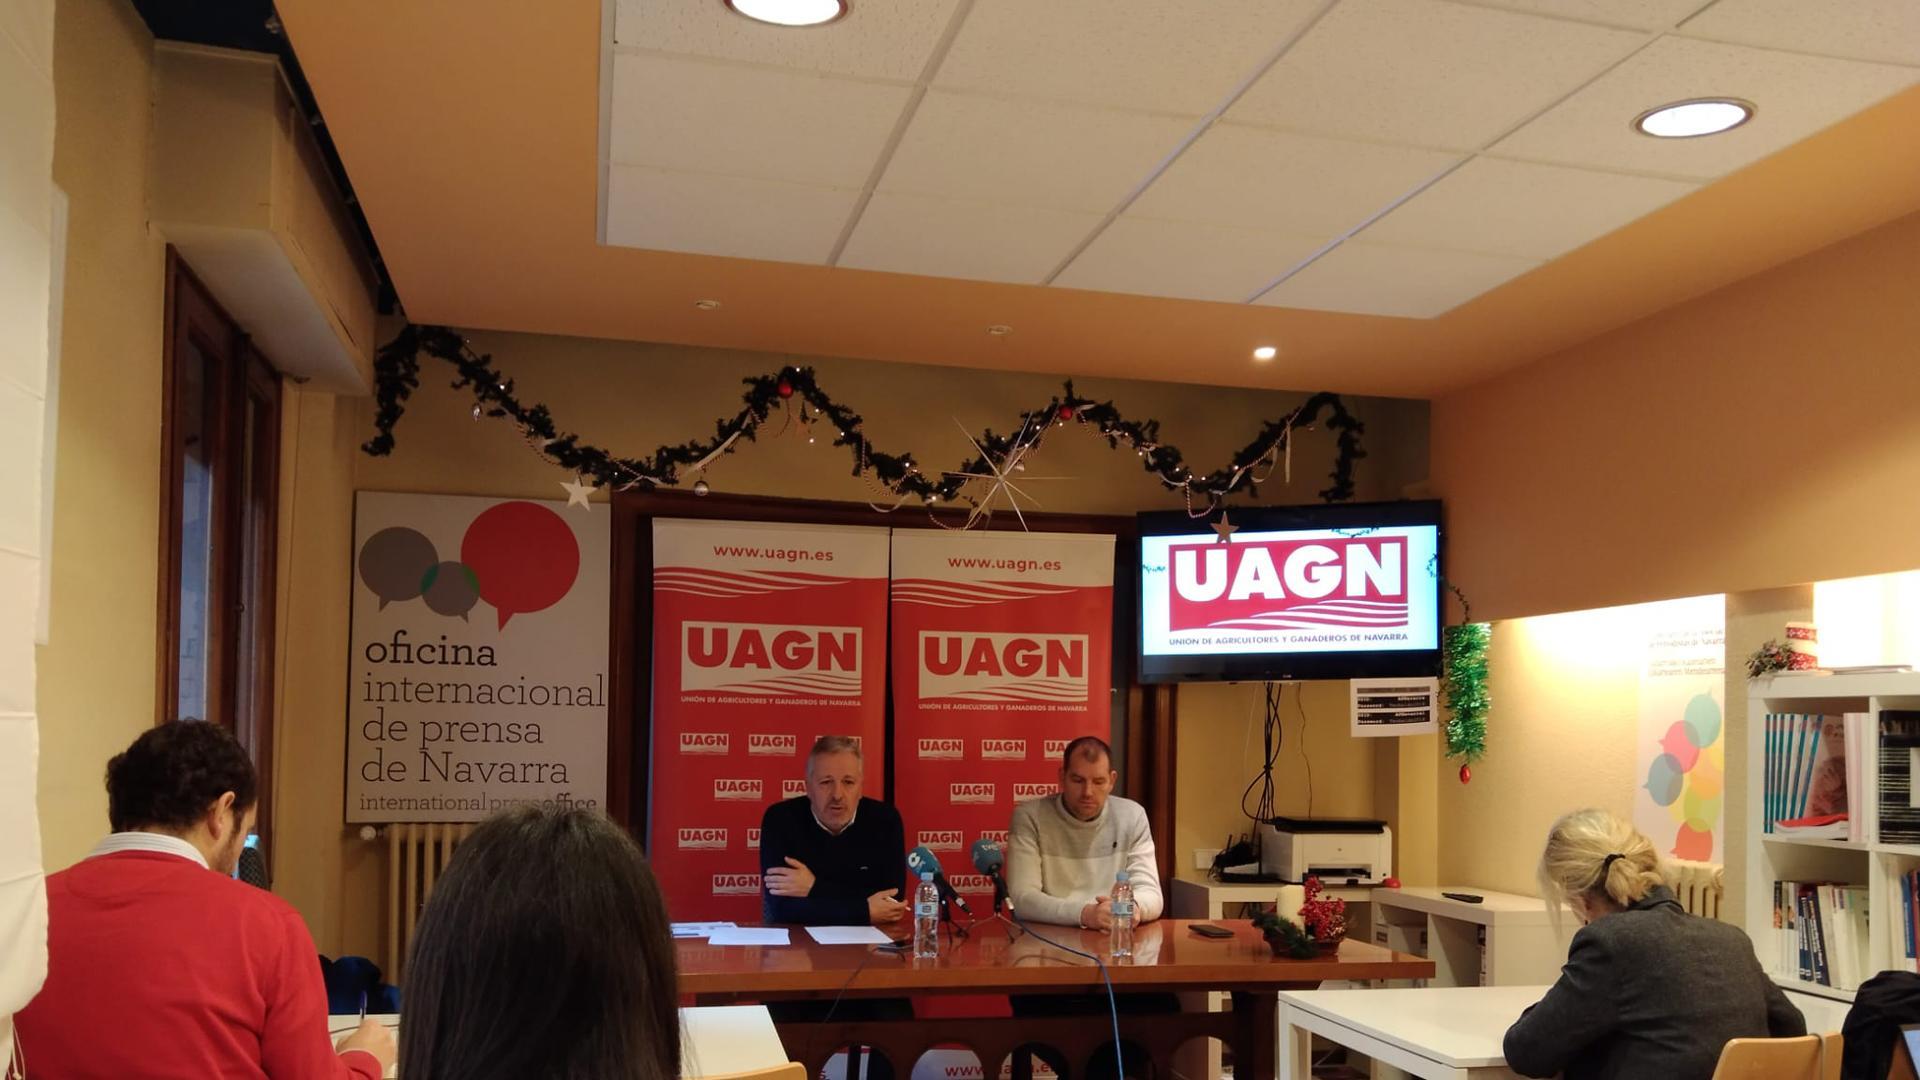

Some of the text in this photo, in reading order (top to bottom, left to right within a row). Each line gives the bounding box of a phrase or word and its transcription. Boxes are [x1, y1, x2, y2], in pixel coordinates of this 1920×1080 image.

[713, 545, 834, 562] www.uagn.es
[947, 557, 1061, 573] www.uagn.es
[1175, 542, 1402, 602] UAGN
[1202, 637, 1212, 645] DE
[1216, 636, 1279, 645] AGRICULTORES
[1282, 635, 1289, 643] Y
[1290, 634, 1347, 643] GANADEROS
[1350, 633, 1361, 642] DE
[1364, 632, 1409, 641] NAVARRA
[365, 630, 497, 666] oficina
[687, 626, 857, 672] UAGN
[924, 636, 1083, 678] UAGN
[363, 672, 606, 708] internacional
[362, 707, 543, 750] de prensa
[681, 734, 727, 746] UAGN
[750, 736, 795, 747] UAGN
[920, 740, 962, 752] UAGN
[983, 741, 1025, 752] UAGN
[1046, 742, 1066, 752] UA
[361, 748, 569, 783] de Navarra
[716, 780, 761, 792] UAGN
[784, 781, 807, 792] UA
[952, 784, 993, 796] UAGN
[360, 792, 486, 811] international
[680, 830, 726, 841] UAGN
[919, 832, 961, 843] UAGN
[714, 875, 759, 887] UAGN
